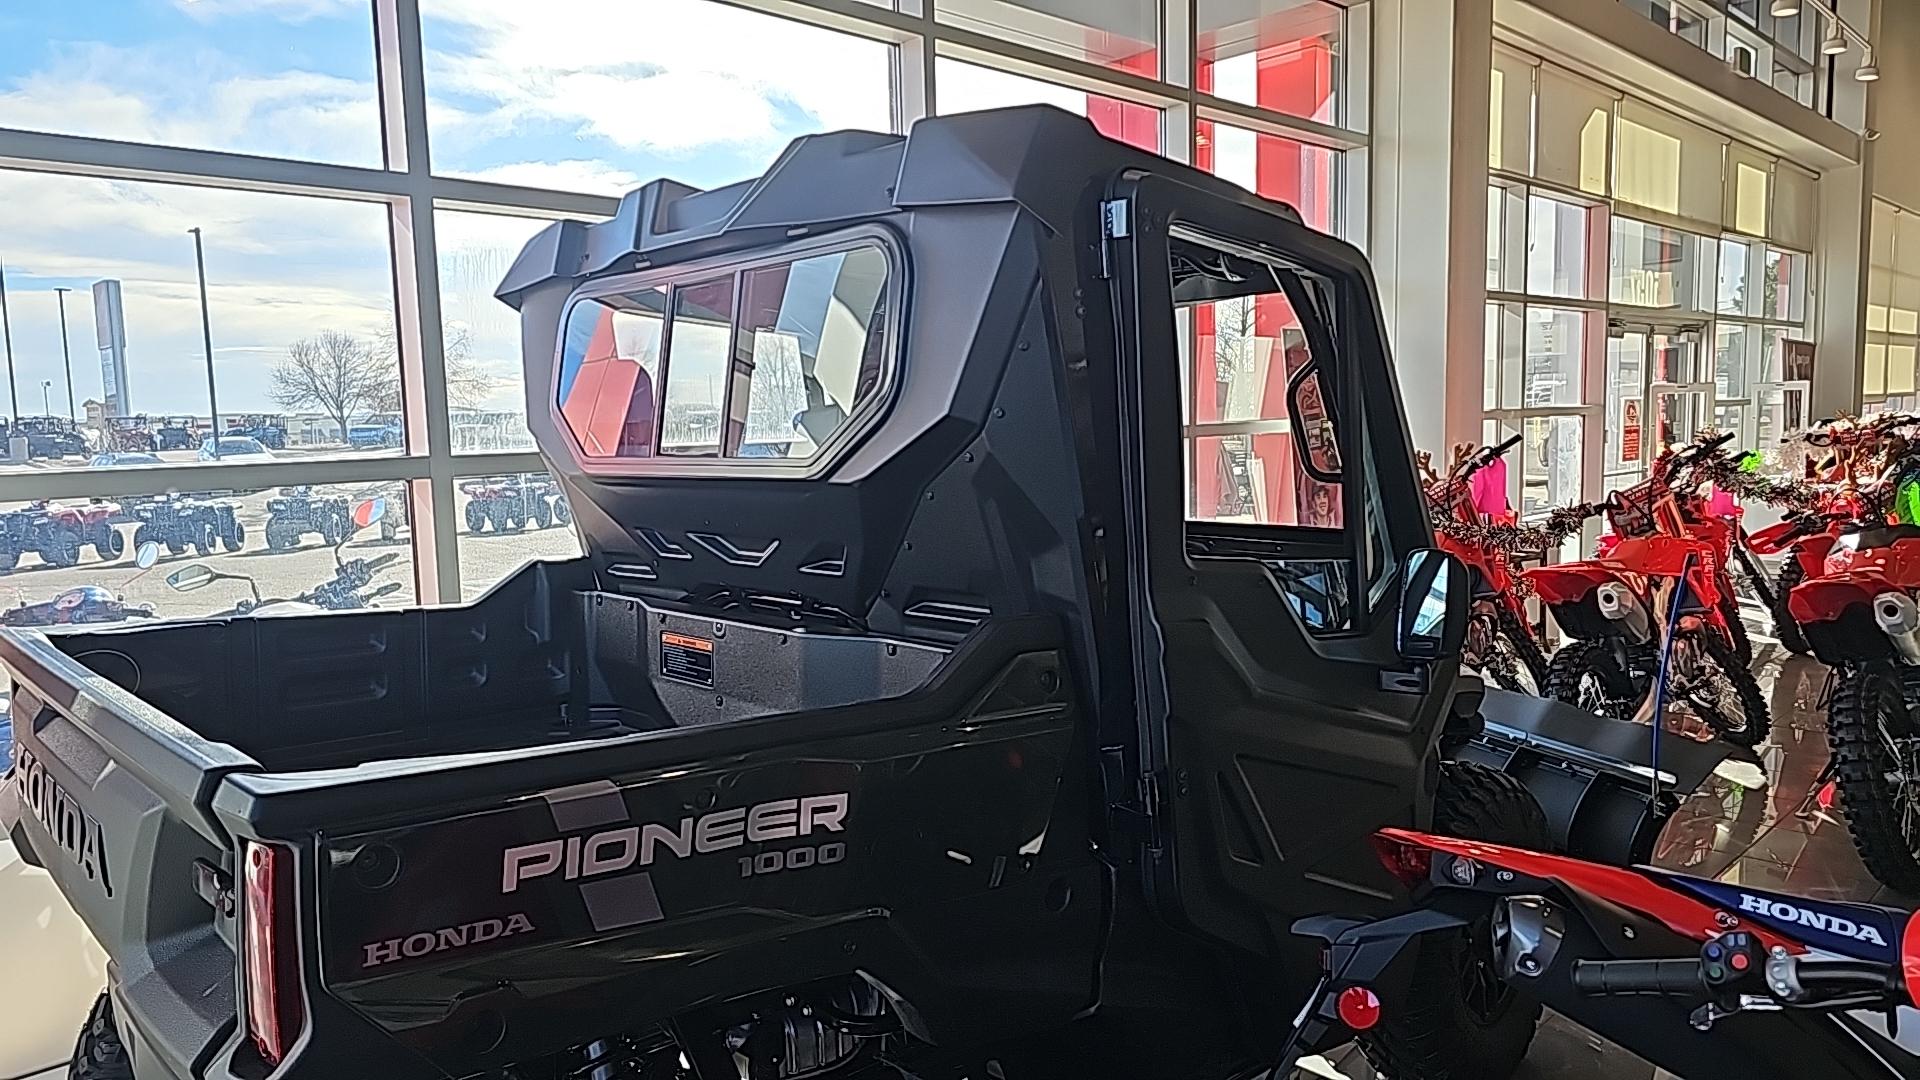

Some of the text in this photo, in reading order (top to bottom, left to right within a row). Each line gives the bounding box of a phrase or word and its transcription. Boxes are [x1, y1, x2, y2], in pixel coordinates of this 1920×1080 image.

[16, 741, 113, 898] HONDA
[502, 792, 849, 893] PIONEER
[737, 842, 846, 877] 1000
[362, 913, 536, 968] HONDA
[1738, 893, 1888, 947] HONDA
